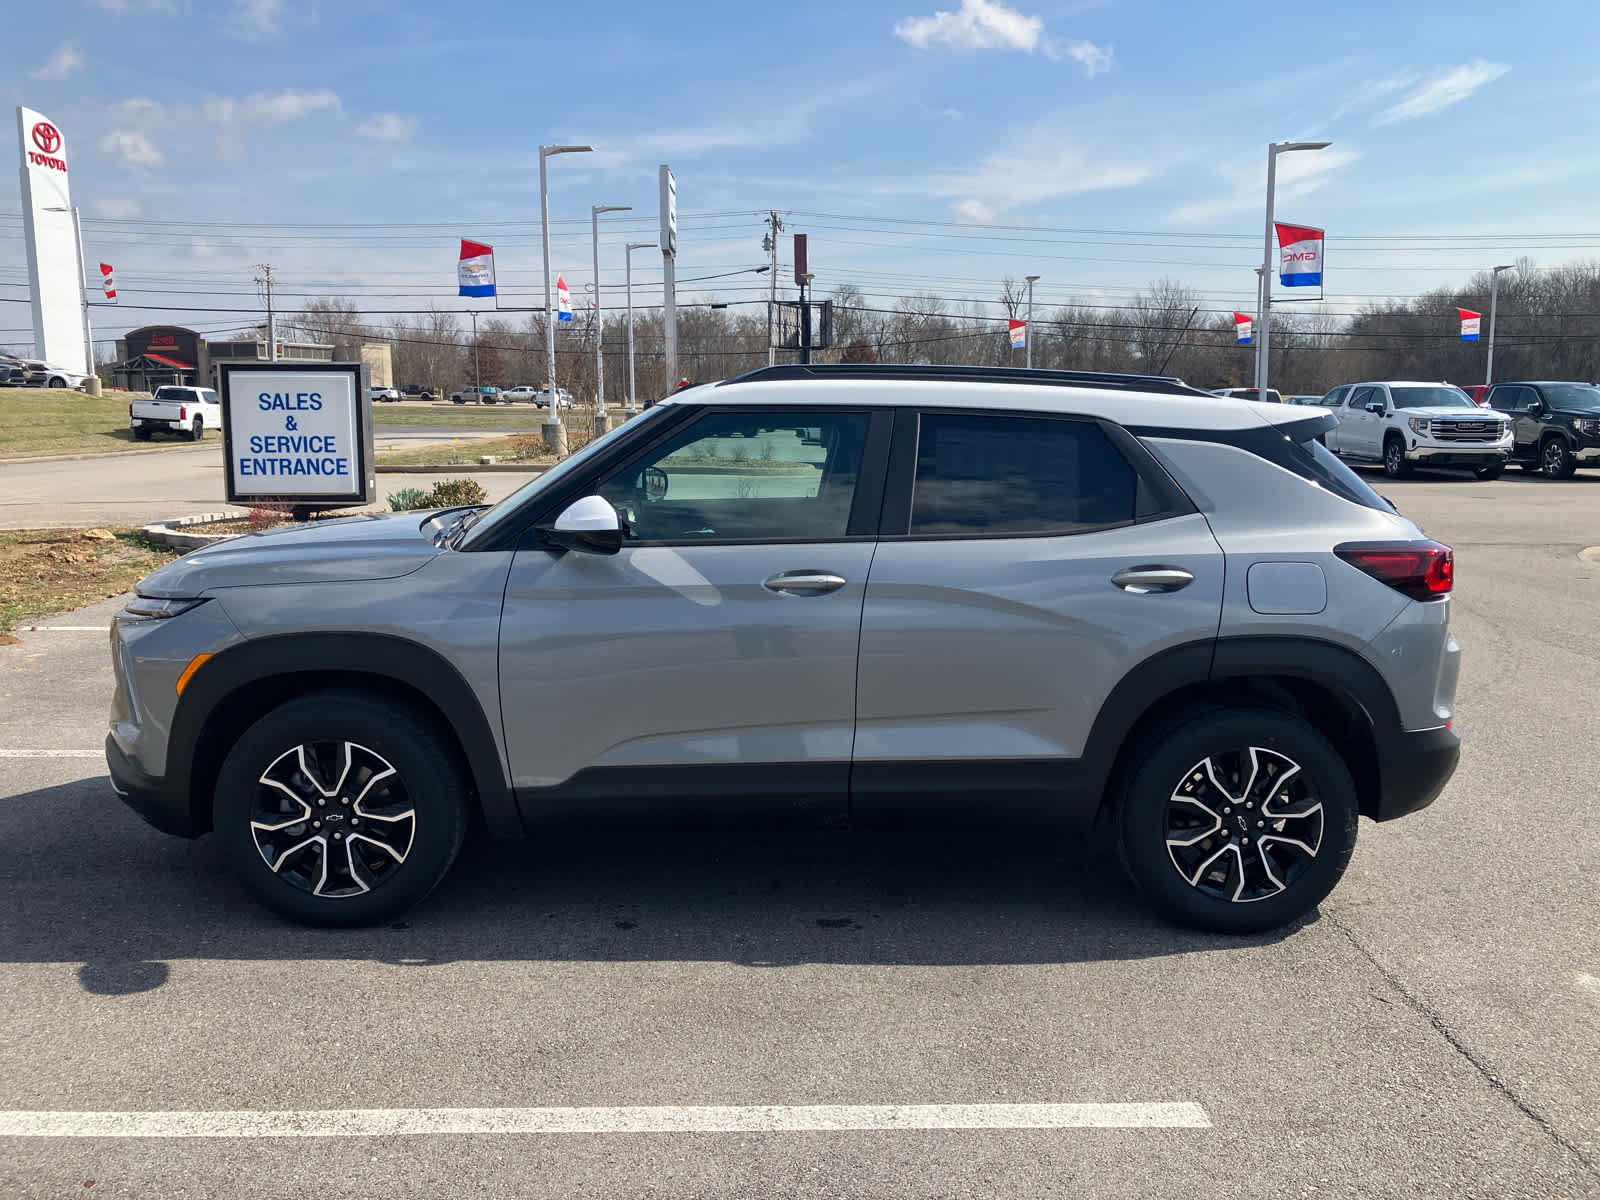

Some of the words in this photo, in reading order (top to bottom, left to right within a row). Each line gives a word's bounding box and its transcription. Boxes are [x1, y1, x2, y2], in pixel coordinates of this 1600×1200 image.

[28, 151, 67, 172] TOYOTA
[258, 392, 323, 411] SALES
[285, 415, 298, 431] &
[249, 435, 337, 454] SERVICE
[240, 458, 349, 476] ENTRANCE
